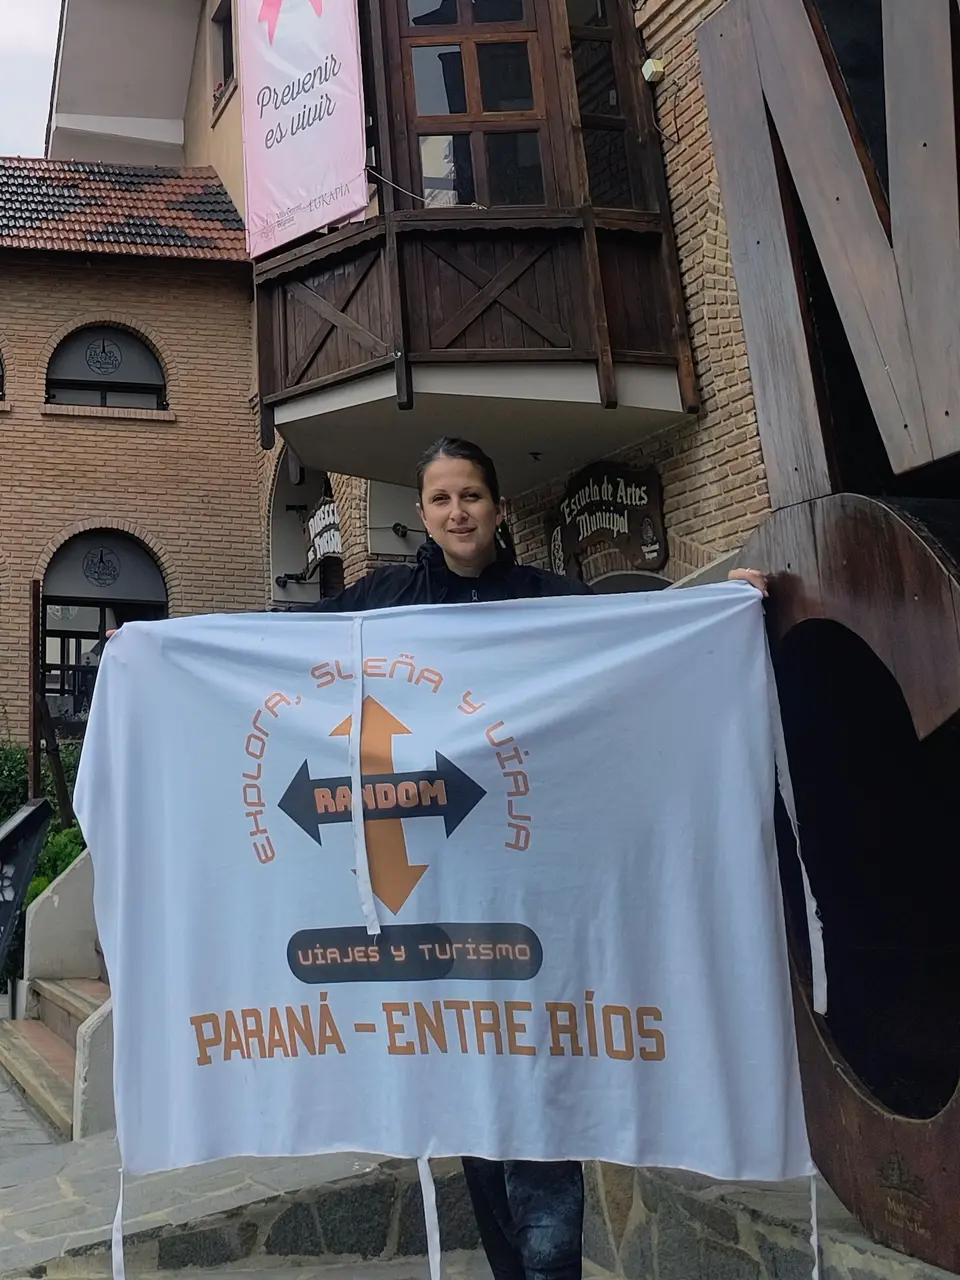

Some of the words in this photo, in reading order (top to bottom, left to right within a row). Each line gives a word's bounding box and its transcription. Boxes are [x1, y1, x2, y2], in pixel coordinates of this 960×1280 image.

[256, 53, 341, 119] Prevenir
[264, 121, 287, 150] es
[290, 93, 337, 137] vivir
[561, 477, 600, 525] Escuela
[601, 475, 613, 501] de
[617, 478, 648, 506] Artes
[576, 506, 628, 542] Municipal
[313, 778, 448, 814] RANDOM
[485, 720, 532, 852] VIAJA
[298, 943, 380, 965] VIAJES
[419, 938, 531, 960] TURISMO
[189, 991, 346, 1067] PARANÁ
[381, 999, 536, 1056] ENTRE
[545, 990, 666, 1062] RÍOS
